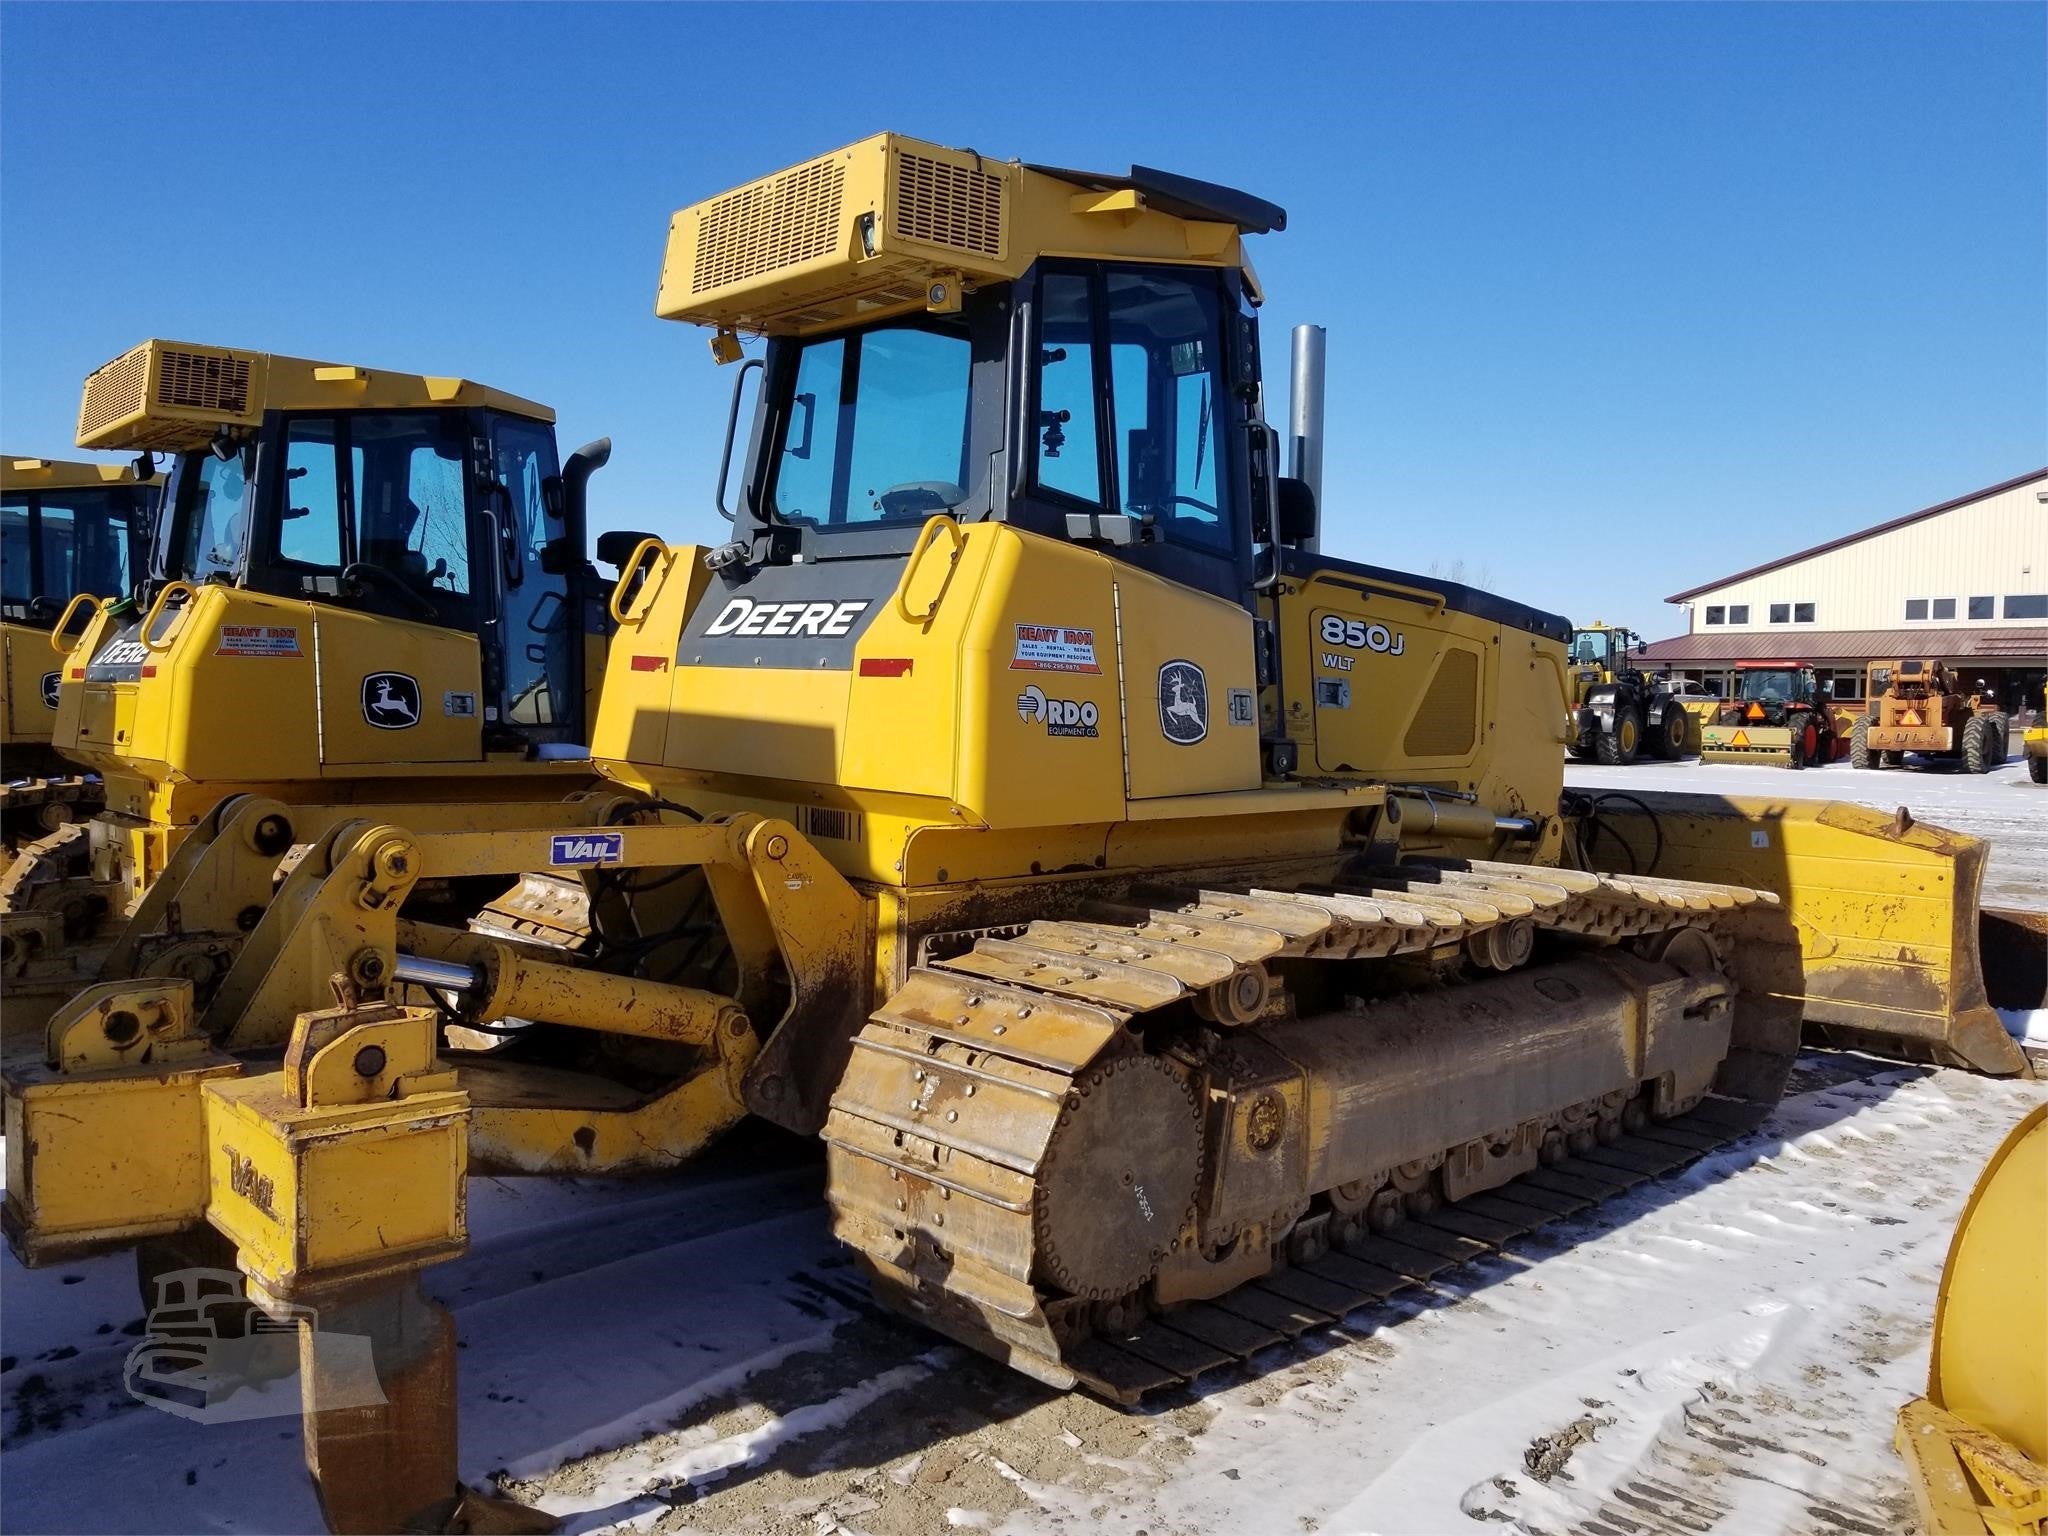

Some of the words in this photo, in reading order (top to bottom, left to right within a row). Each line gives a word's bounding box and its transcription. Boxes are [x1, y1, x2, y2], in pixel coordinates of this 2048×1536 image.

[702, 598, 869, 636] DEERE
[1018, 626, 1059, 643] HEAVY
[1063, 630, 1092, 646] IRON
[1321, 615, 1404, 655] 850J
[1322, 653, 1355, 671] WLT
[1049, 727, 1086, 736] EQUIPMENT
[554, 840, 618, 859] VAIL
